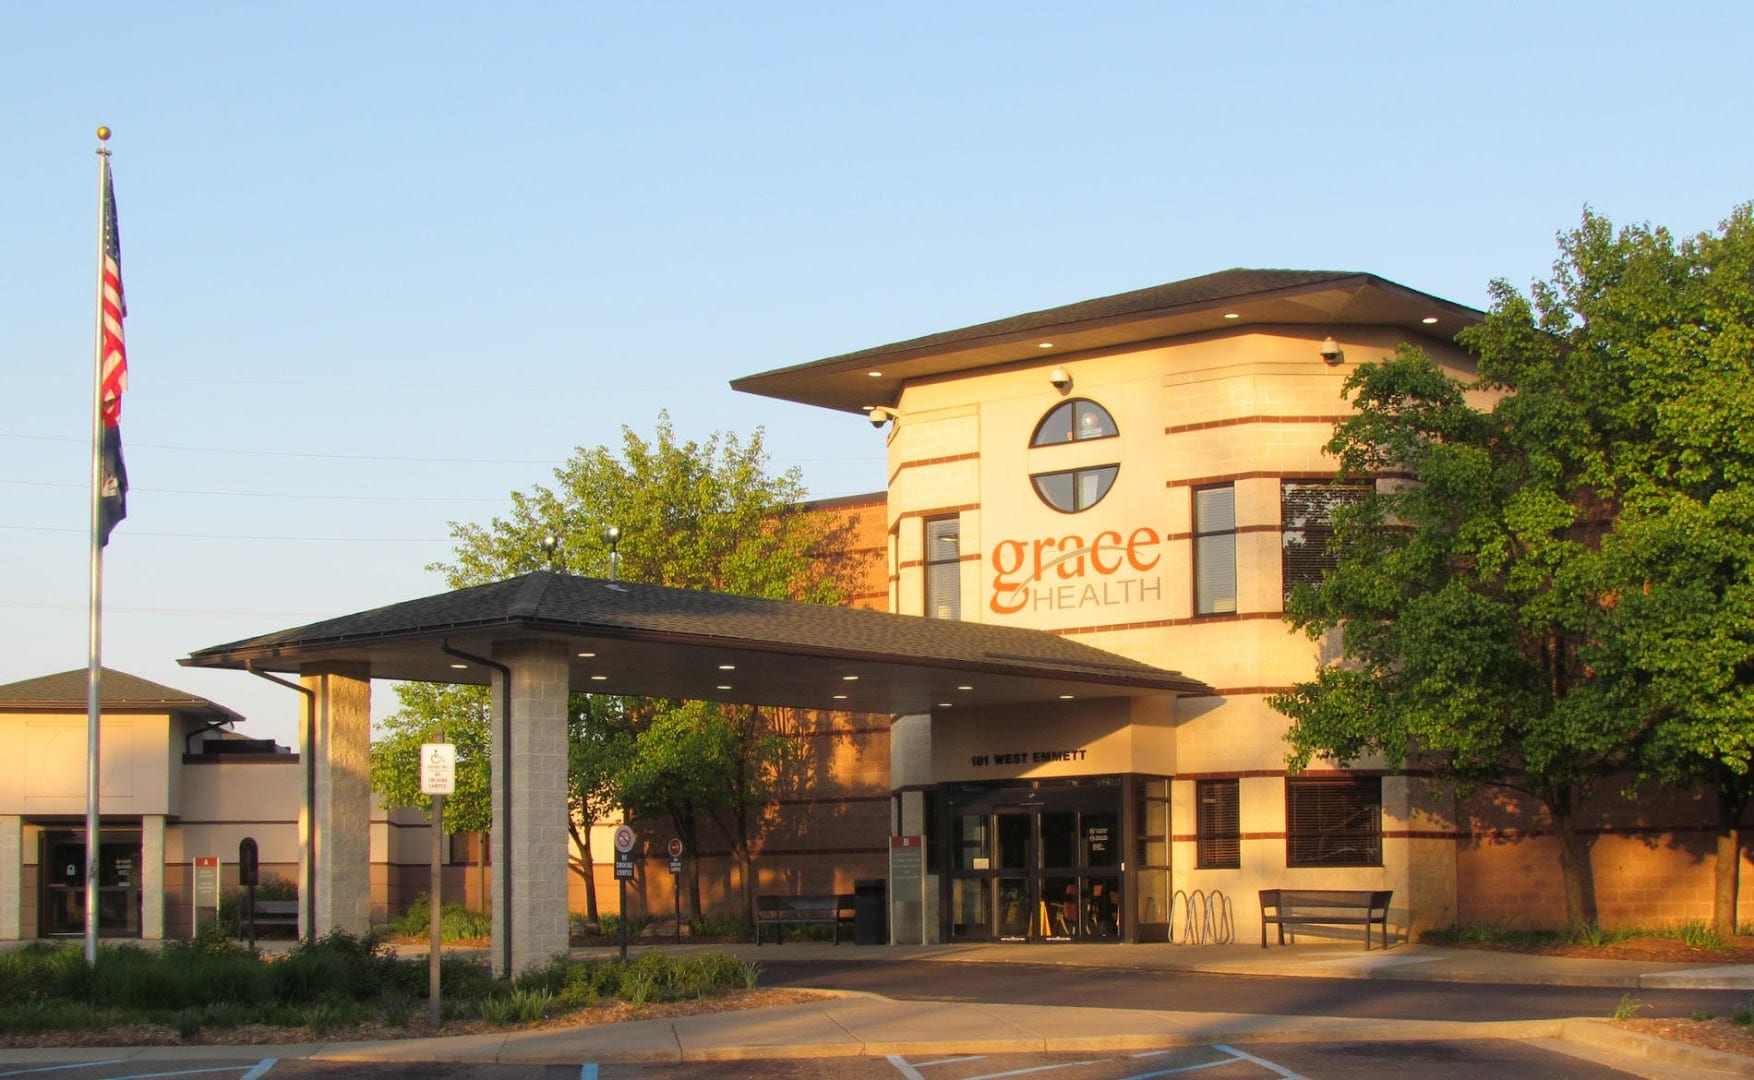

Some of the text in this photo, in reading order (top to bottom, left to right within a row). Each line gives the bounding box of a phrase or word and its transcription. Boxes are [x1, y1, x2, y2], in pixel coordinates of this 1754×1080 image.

[990, 527, 1161, 614] grace
[1033, 577, 1161, 612] HEALTH
[994, 753, 1028, 765] WEST
[1032, 750, 1087, 763] EMMETT
